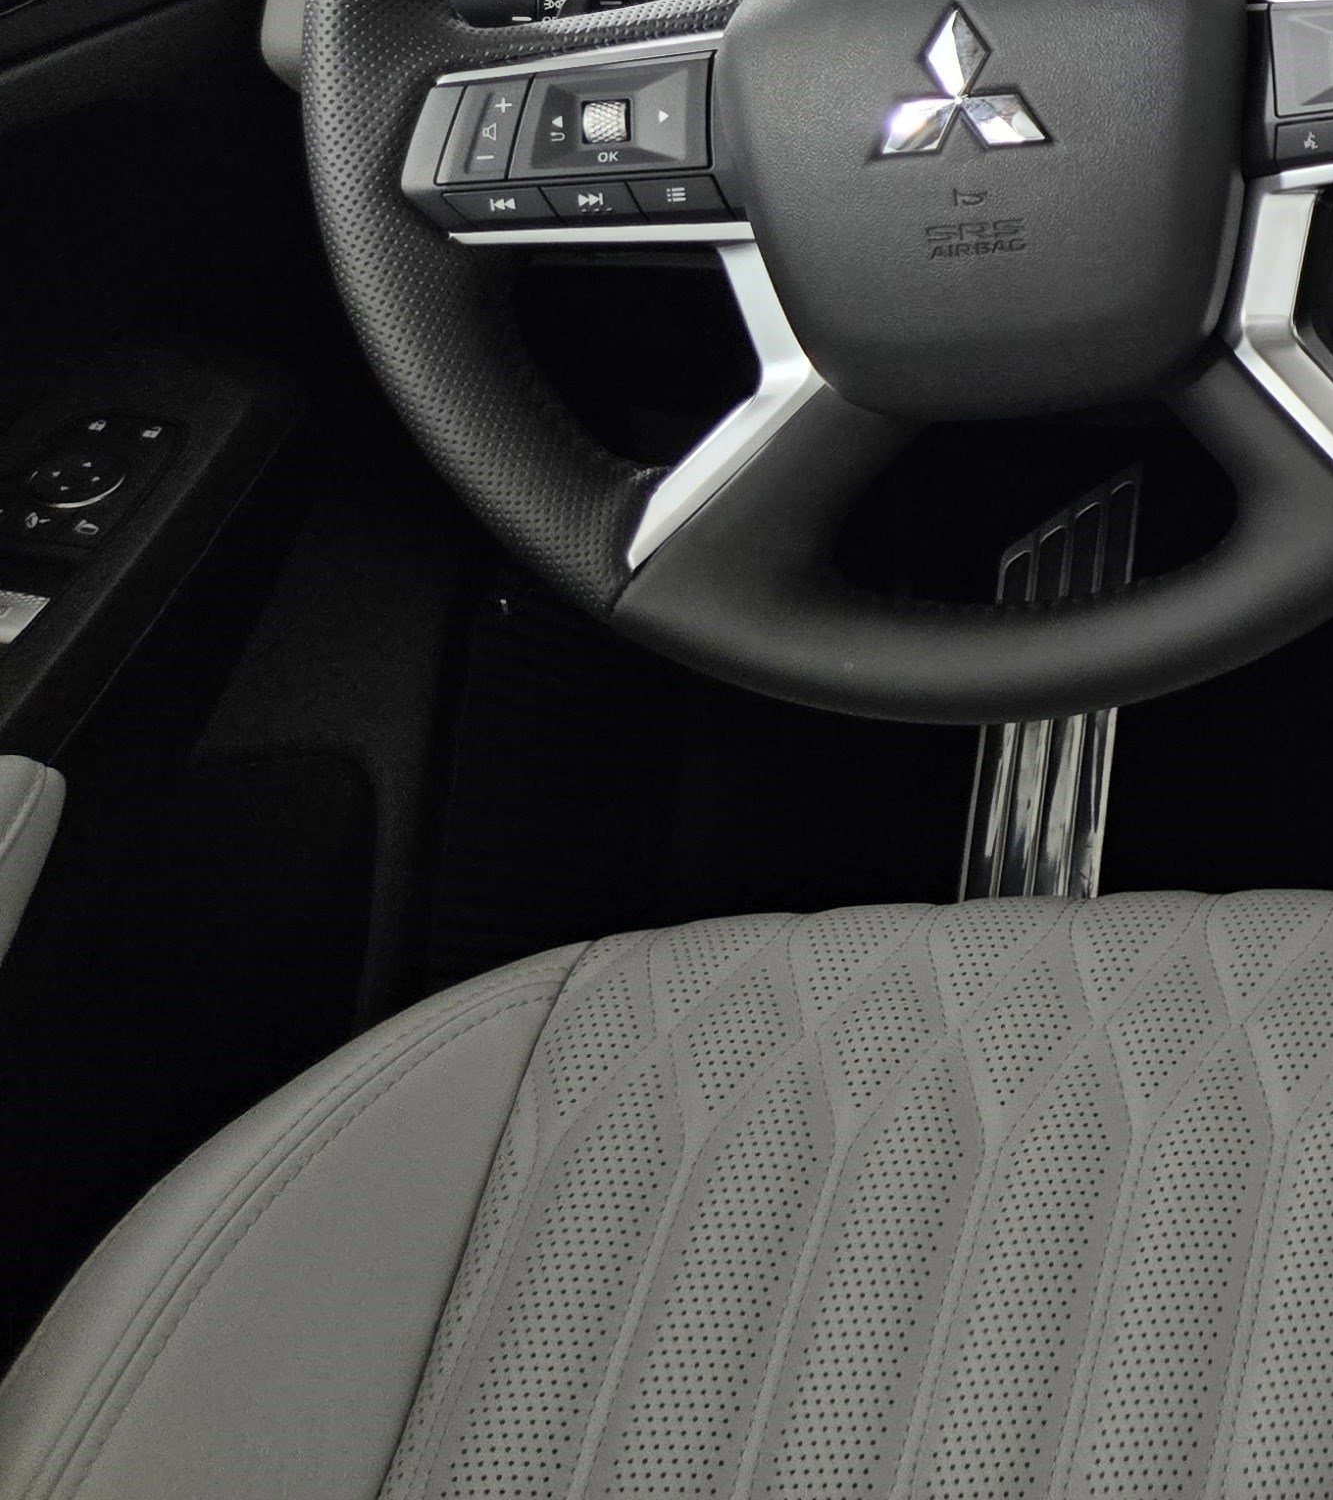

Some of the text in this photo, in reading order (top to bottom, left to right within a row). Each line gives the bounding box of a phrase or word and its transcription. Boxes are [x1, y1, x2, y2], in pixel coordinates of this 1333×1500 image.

[597, 150, 619, 163] OK
[925, 217, 1025, 243] SRS
[929, 237, 1028, 261] AIRBAG
